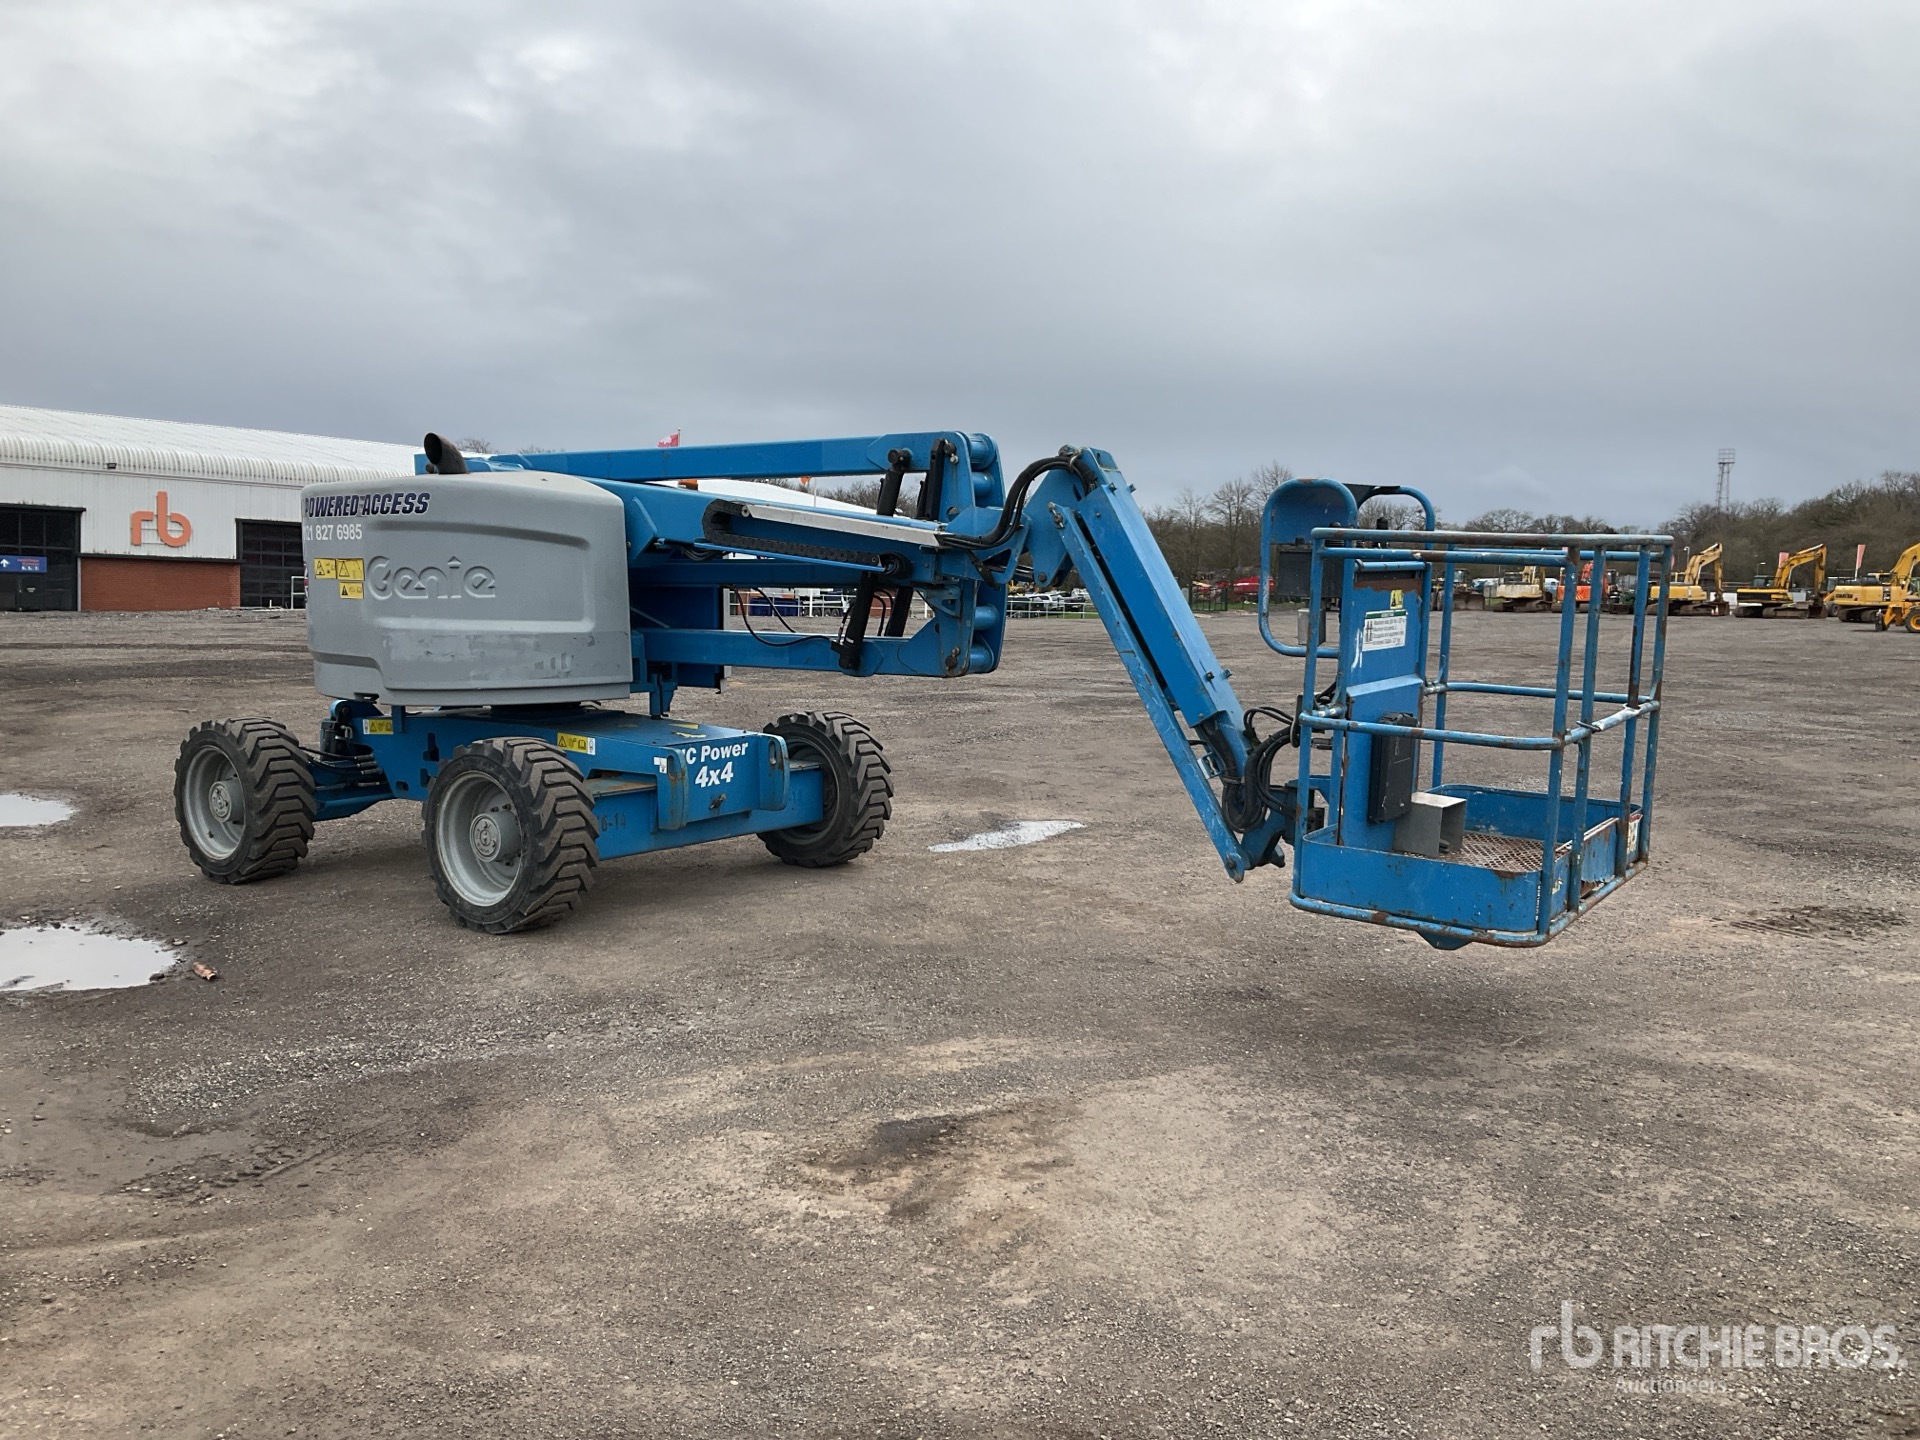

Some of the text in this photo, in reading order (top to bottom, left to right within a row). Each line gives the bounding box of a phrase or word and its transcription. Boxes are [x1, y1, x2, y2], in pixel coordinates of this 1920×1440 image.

[361, 492, 430, 515] ACCESS
[131, 491, 192, 548] rb
[315, 525, 334, 541] 827
[336, 524, 363, 540] 6985
[367, 556, 496, 600] Genie
[701, 742, 748, 762] Power
[695, 762, 734, 788] 4x4
